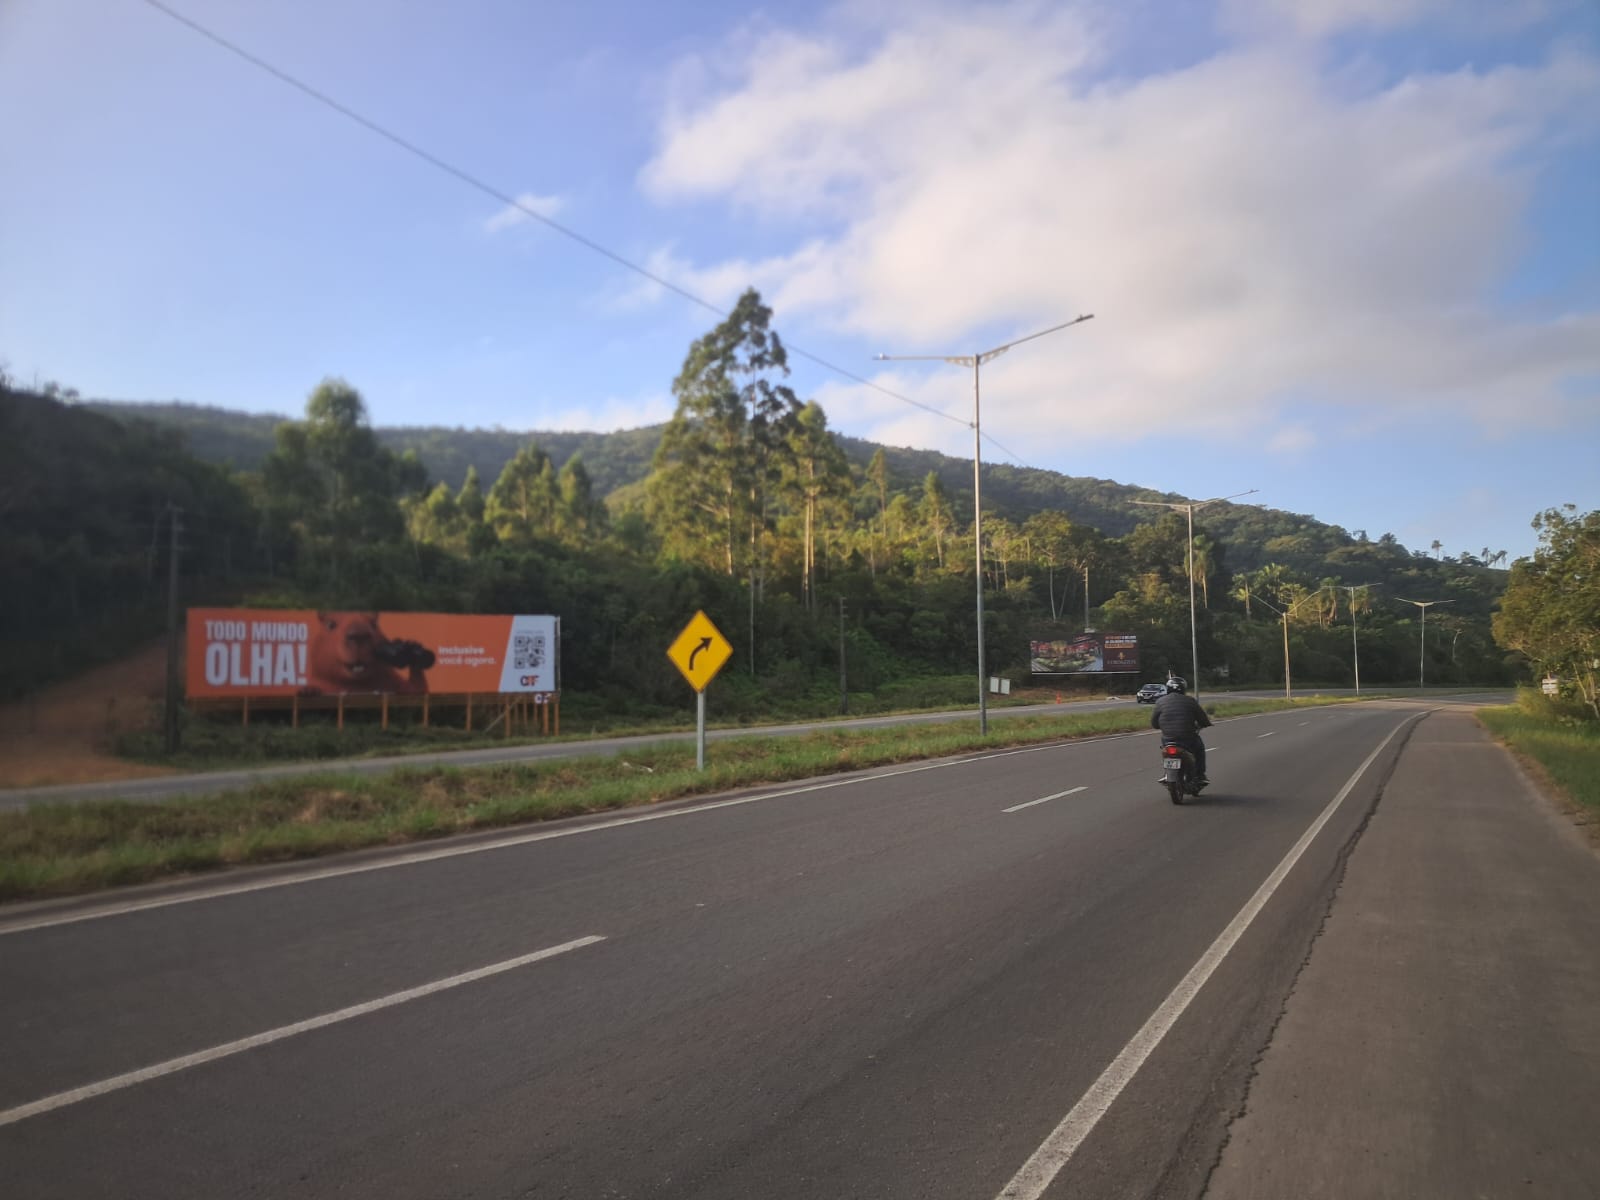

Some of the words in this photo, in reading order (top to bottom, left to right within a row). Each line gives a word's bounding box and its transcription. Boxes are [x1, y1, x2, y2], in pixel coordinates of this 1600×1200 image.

[205, 620, 246, 640] TODO
[251, 621, 308, 641] MUNDO
[205, 641, 308, 686] OLHA!
